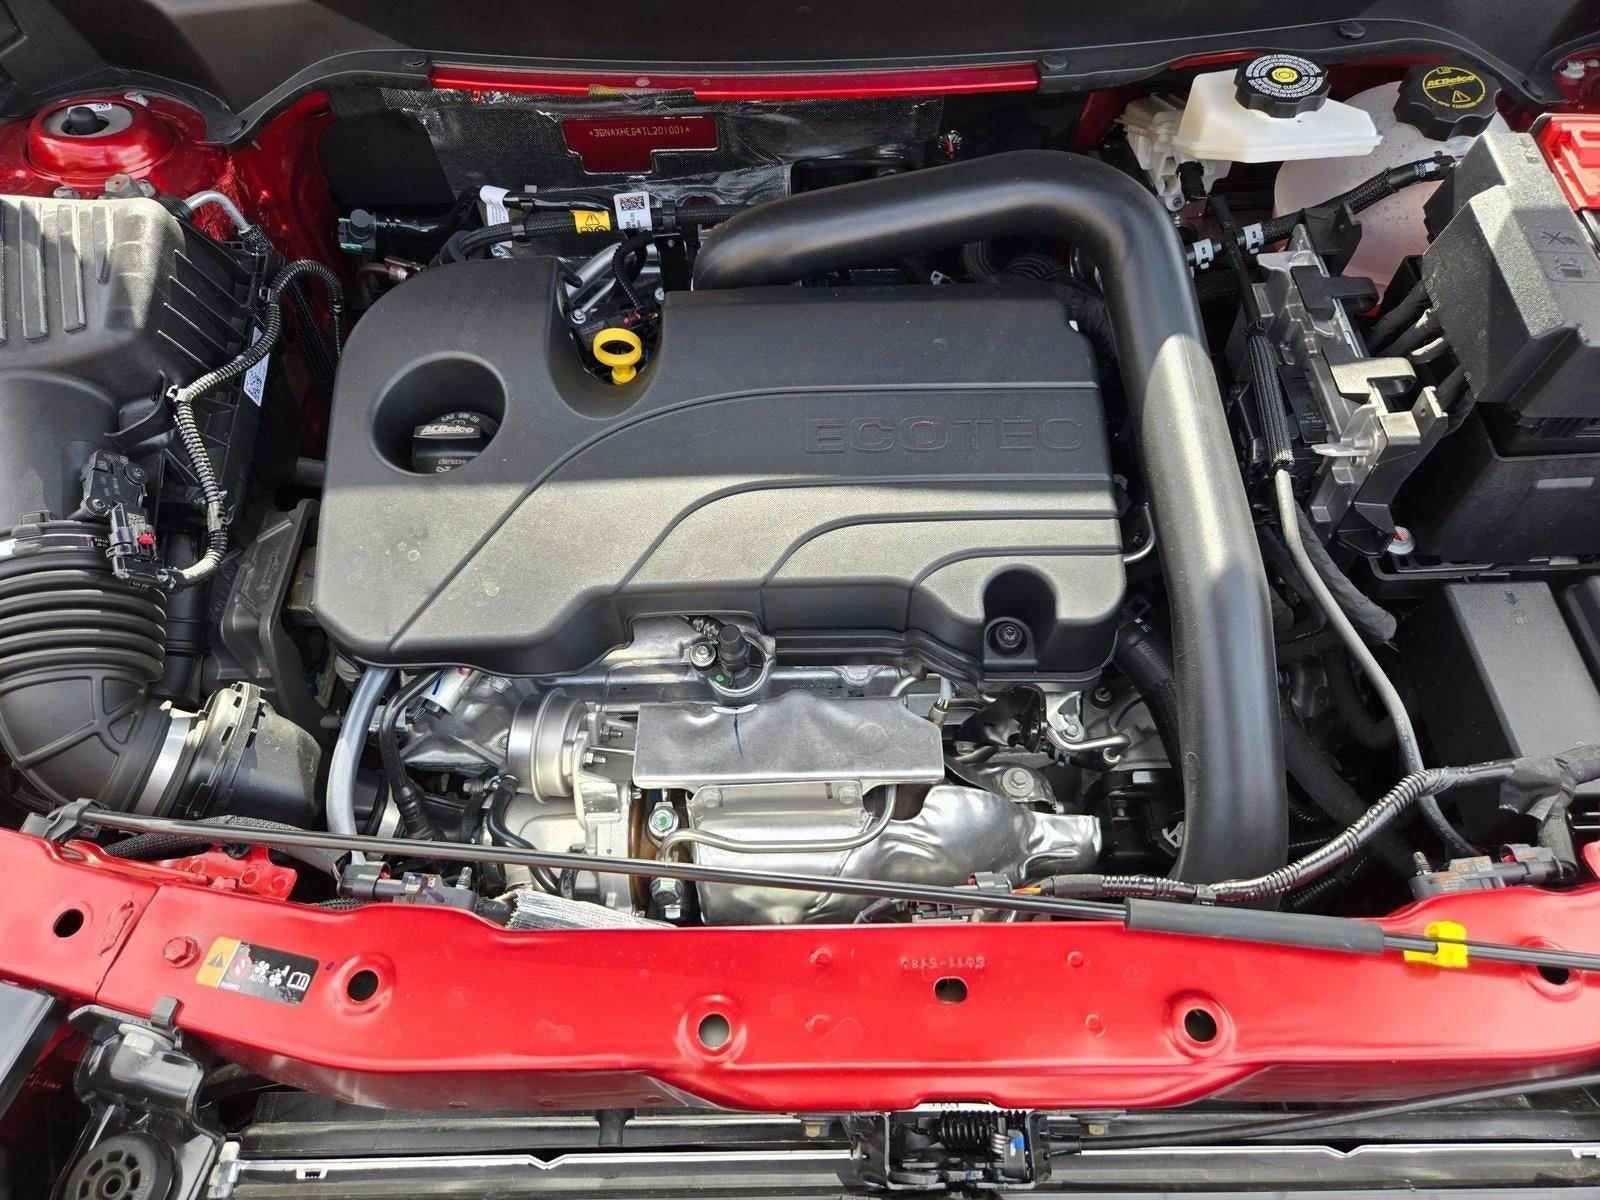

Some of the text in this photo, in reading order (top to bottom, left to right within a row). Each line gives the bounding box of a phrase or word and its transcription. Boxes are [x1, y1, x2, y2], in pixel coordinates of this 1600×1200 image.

[1426, 75, 1476, 87] ACDelco
[441, 412, 480, 423] SAE 0W-20
[420, 425, 475, 436] ACDelco
[805, 416, 1084, 453] ECOTEC
[248, 973, 267, 984] AUTO
